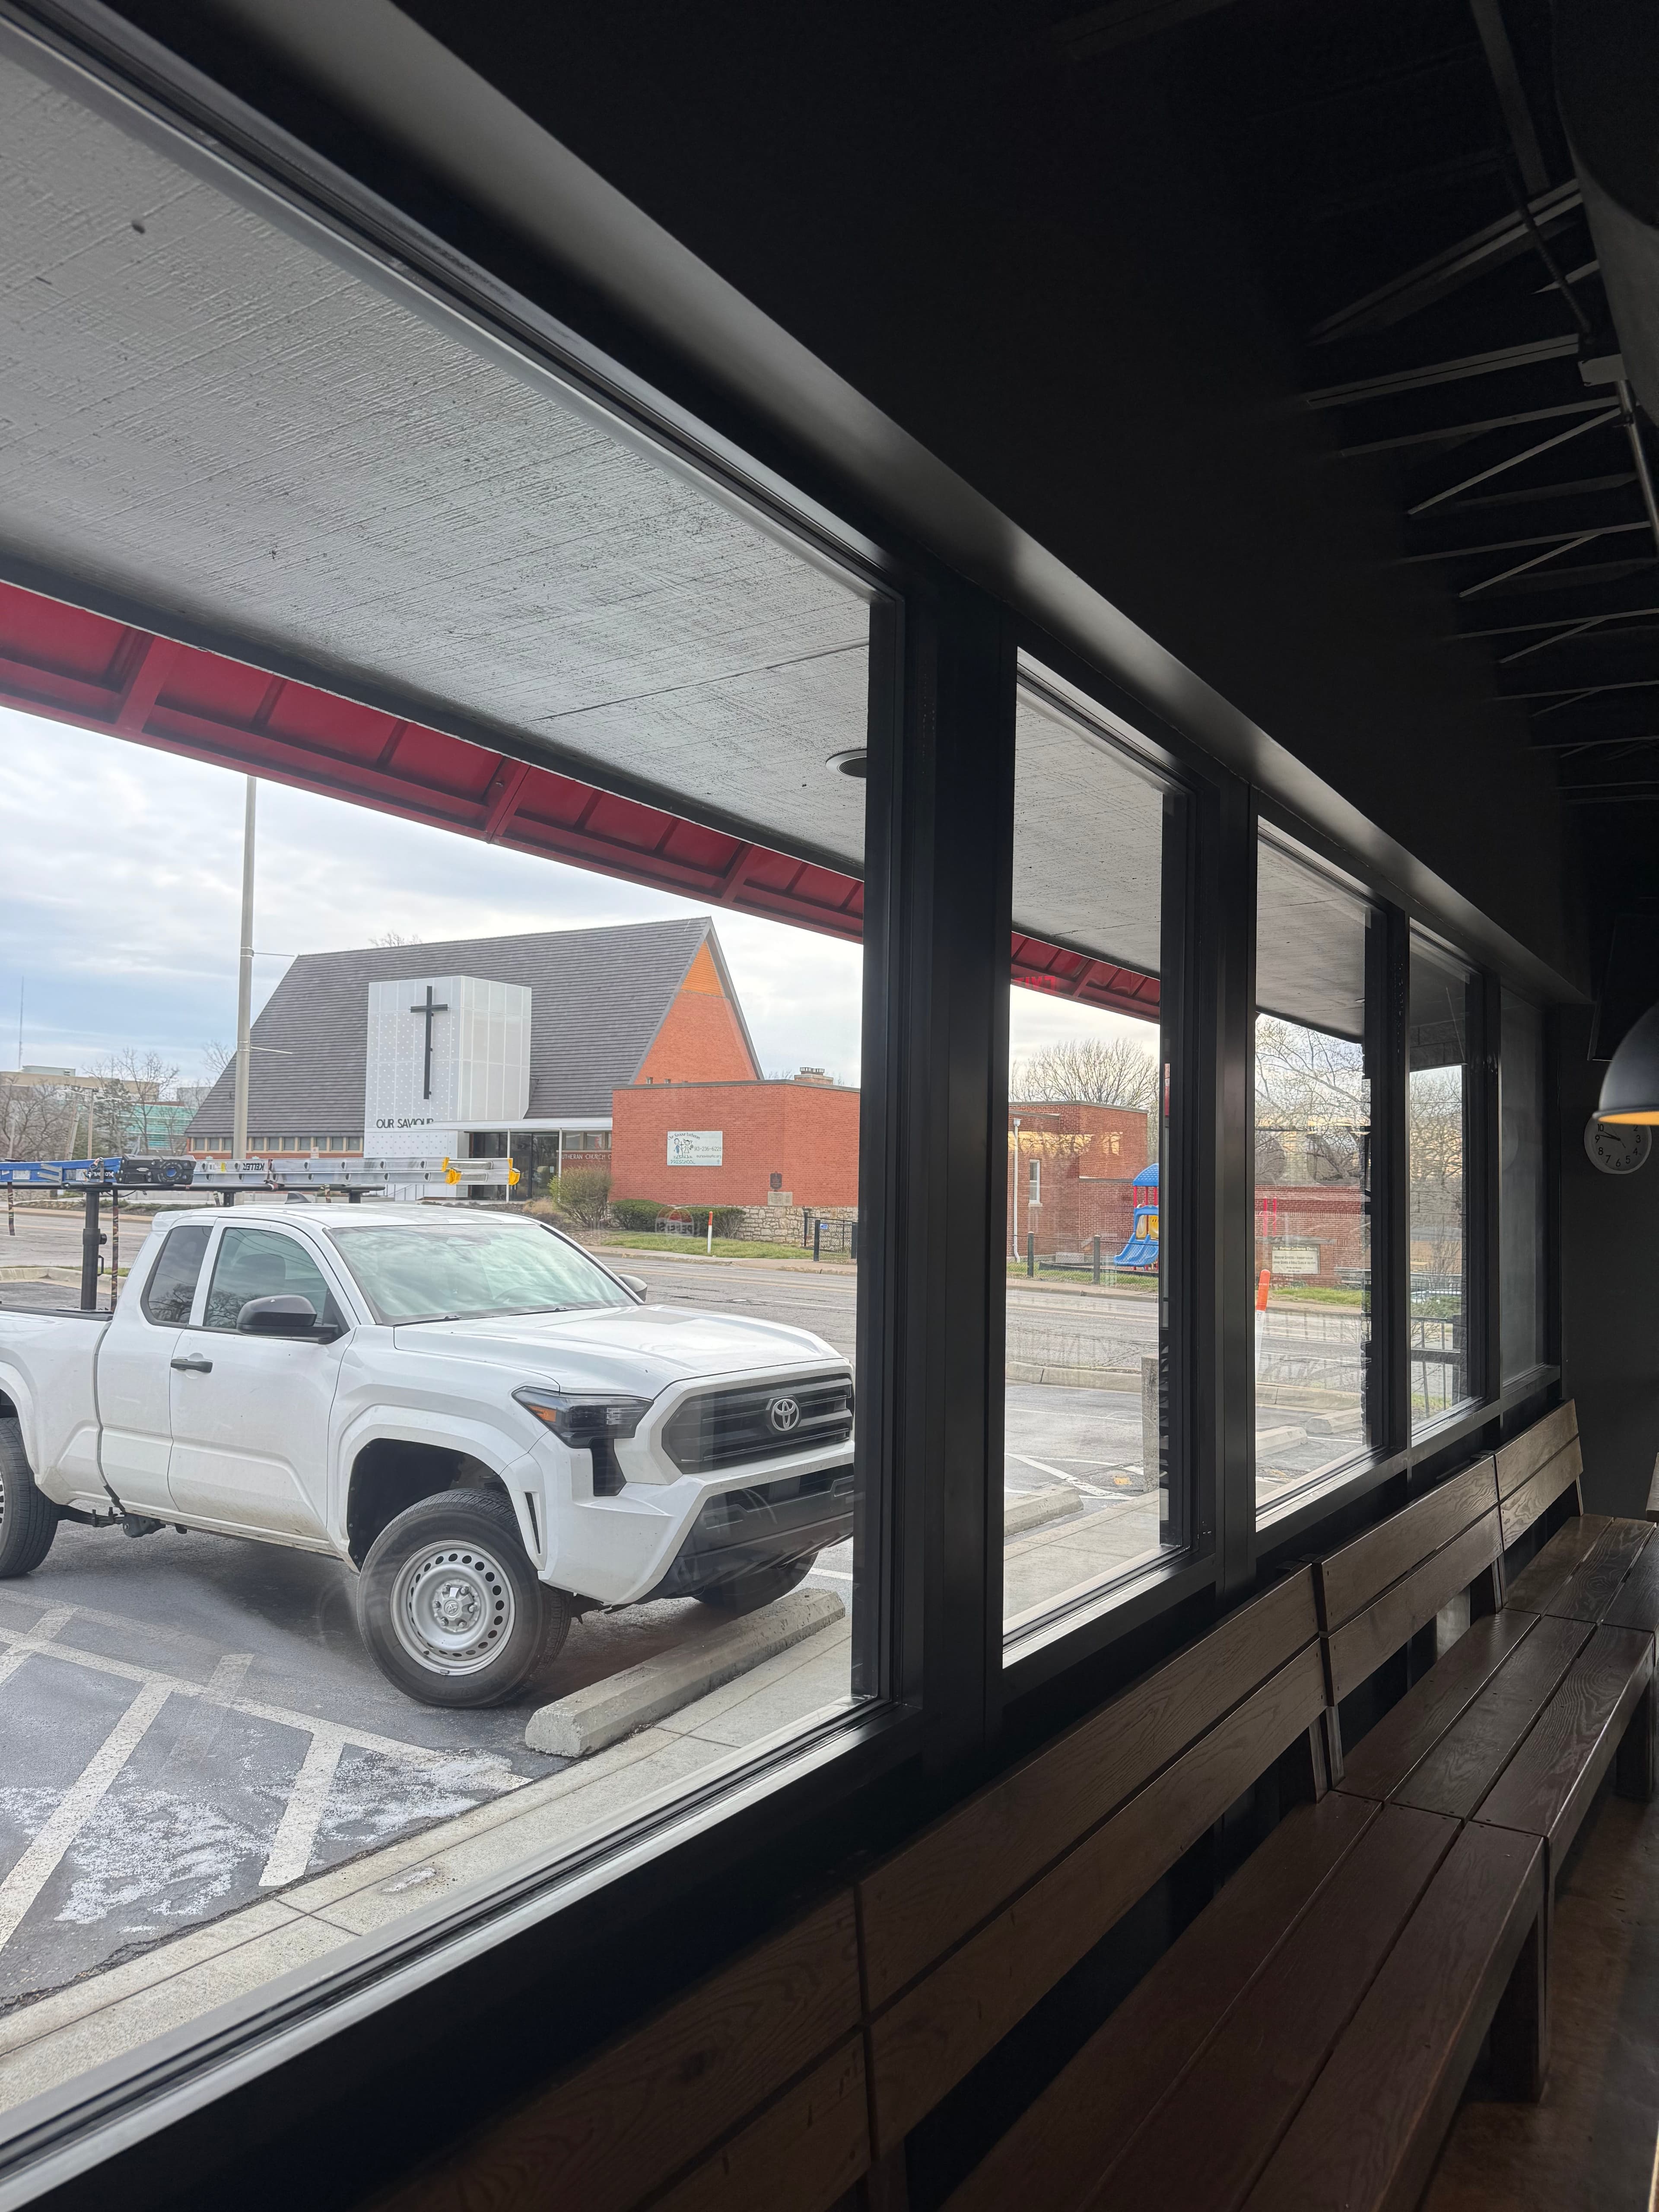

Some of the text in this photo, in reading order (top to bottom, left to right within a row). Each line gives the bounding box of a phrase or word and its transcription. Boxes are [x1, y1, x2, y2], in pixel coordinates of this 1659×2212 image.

[376, 1119, 394, 1128] OUR
[1597, 1124, 1604, 1132] 10
[1595, 1135, 1600, 1144] 9
[1636, 1135, 1641, 1143] 3
[1633, 1147, 1638, 1156] 4
[1615, 1158, 1621, 1167] 6
[1626, 1156, 1630, 1164] 5
